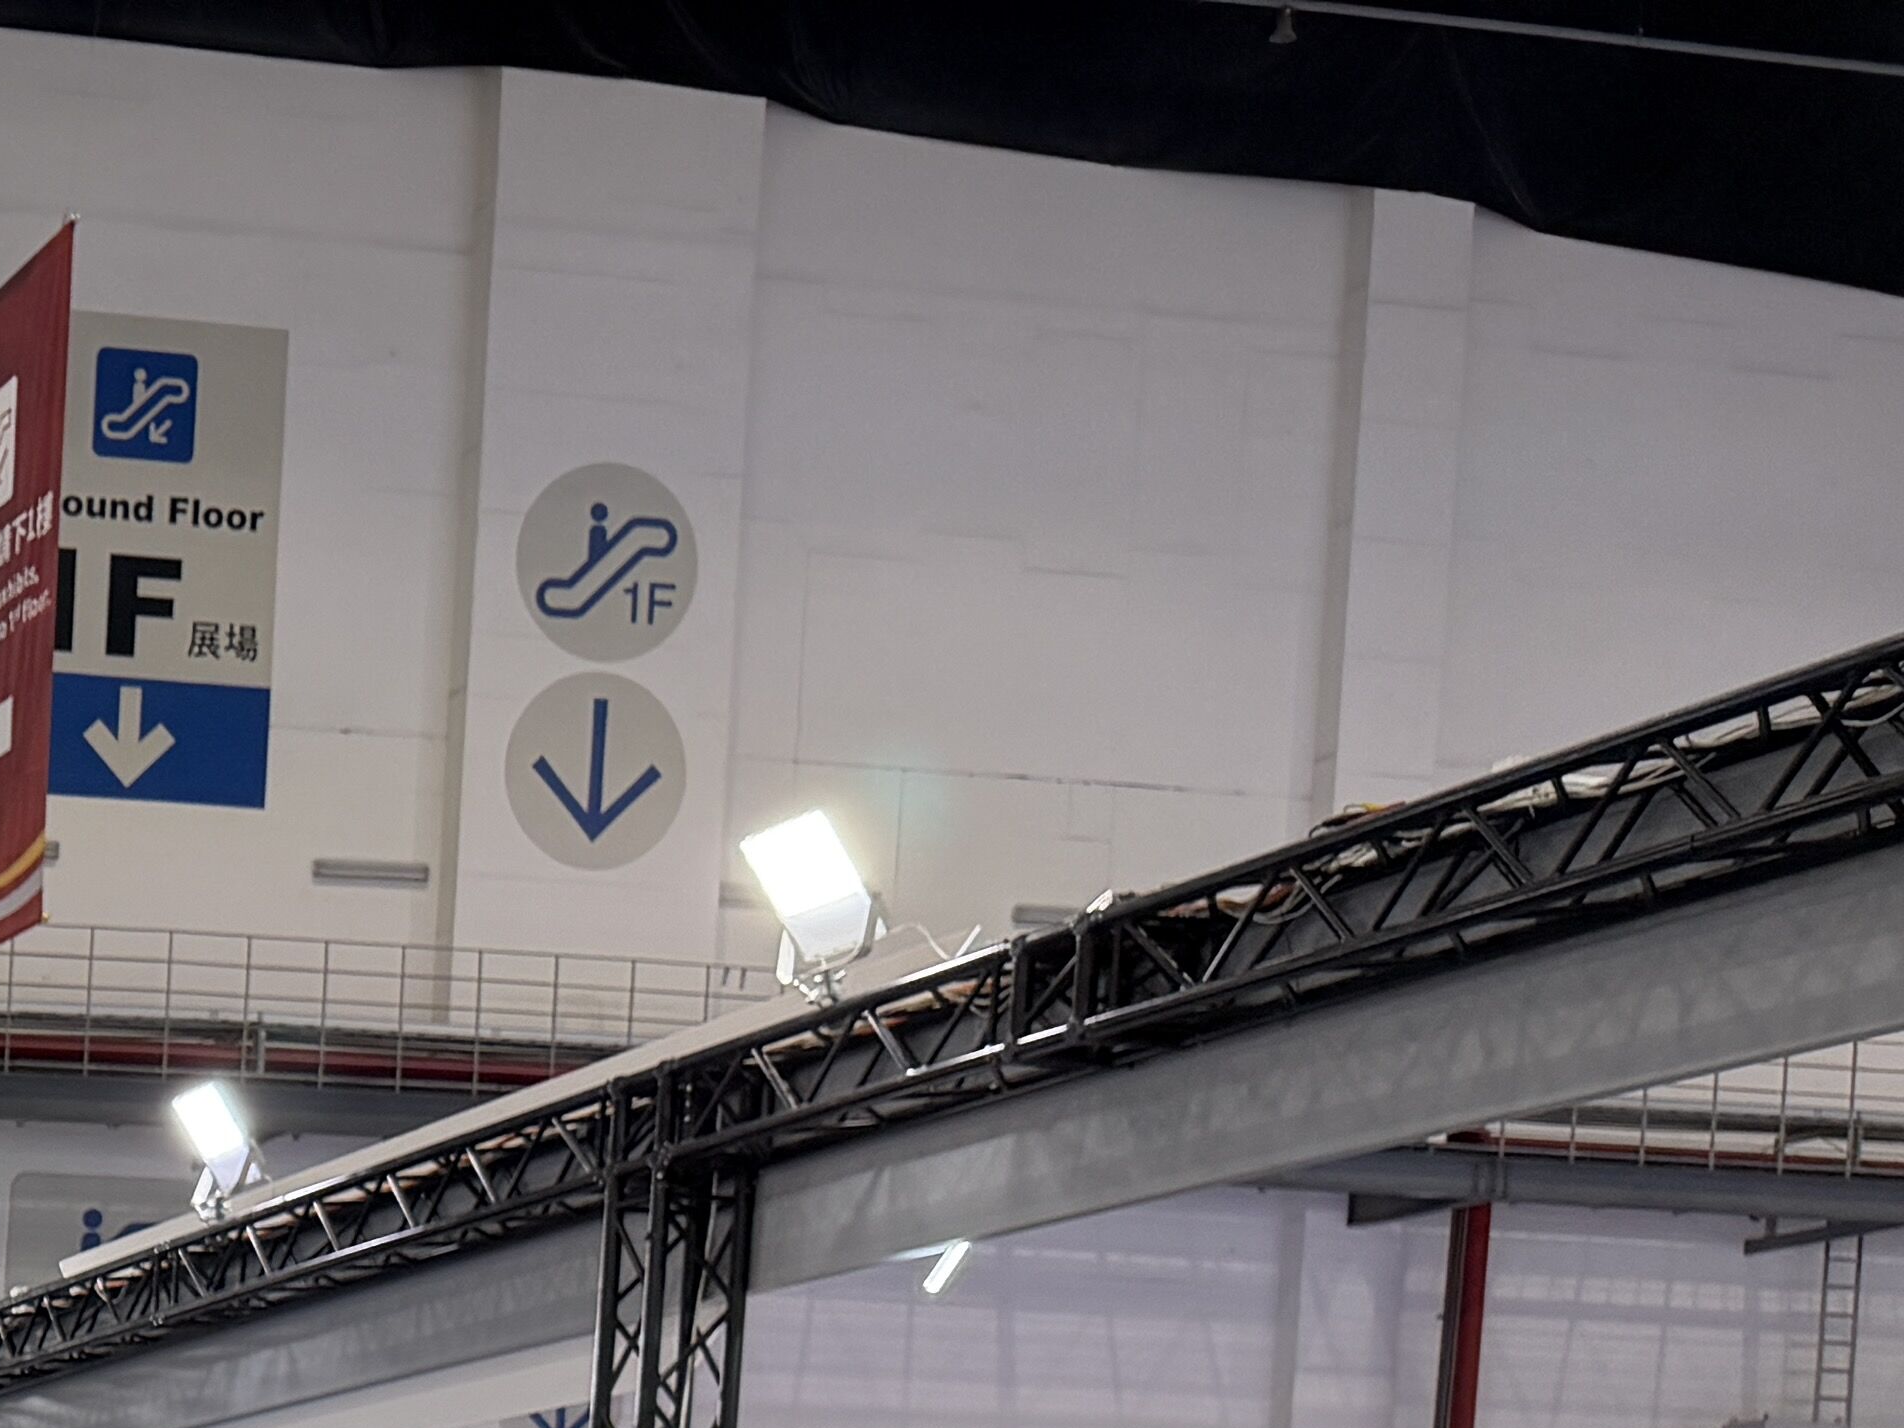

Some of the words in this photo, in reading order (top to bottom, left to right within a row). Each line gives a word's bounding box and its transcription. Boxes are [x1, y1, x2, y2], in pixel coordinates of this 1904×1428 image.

[63, 495, 154, 523] ound
[169, 497, 264, 531] Floor
[623, 582, 676, 625] 1F
[188, 621, 258, 662] 展場
